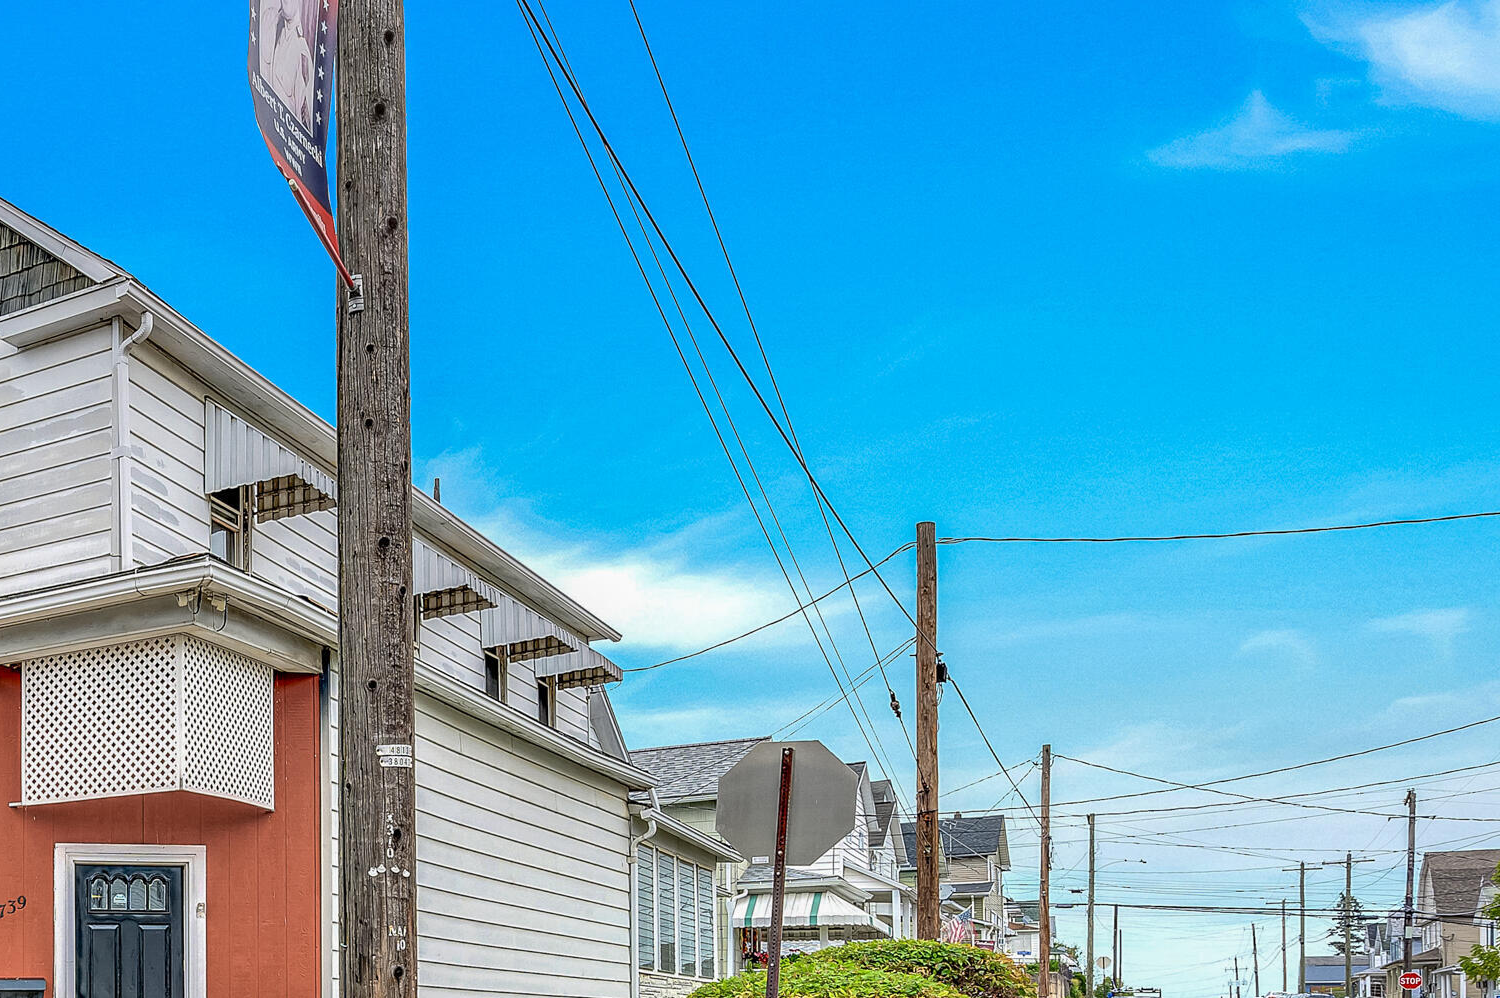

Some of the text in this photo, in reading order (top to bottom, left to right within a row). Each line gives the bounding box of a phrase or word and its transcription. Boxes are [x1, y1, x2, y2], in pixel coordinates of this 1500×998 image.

[251, 71, 277, 113] Albert
[285, 111, 323, 168] Czarnecki
[1400, 977, 1421, 985] STOP
